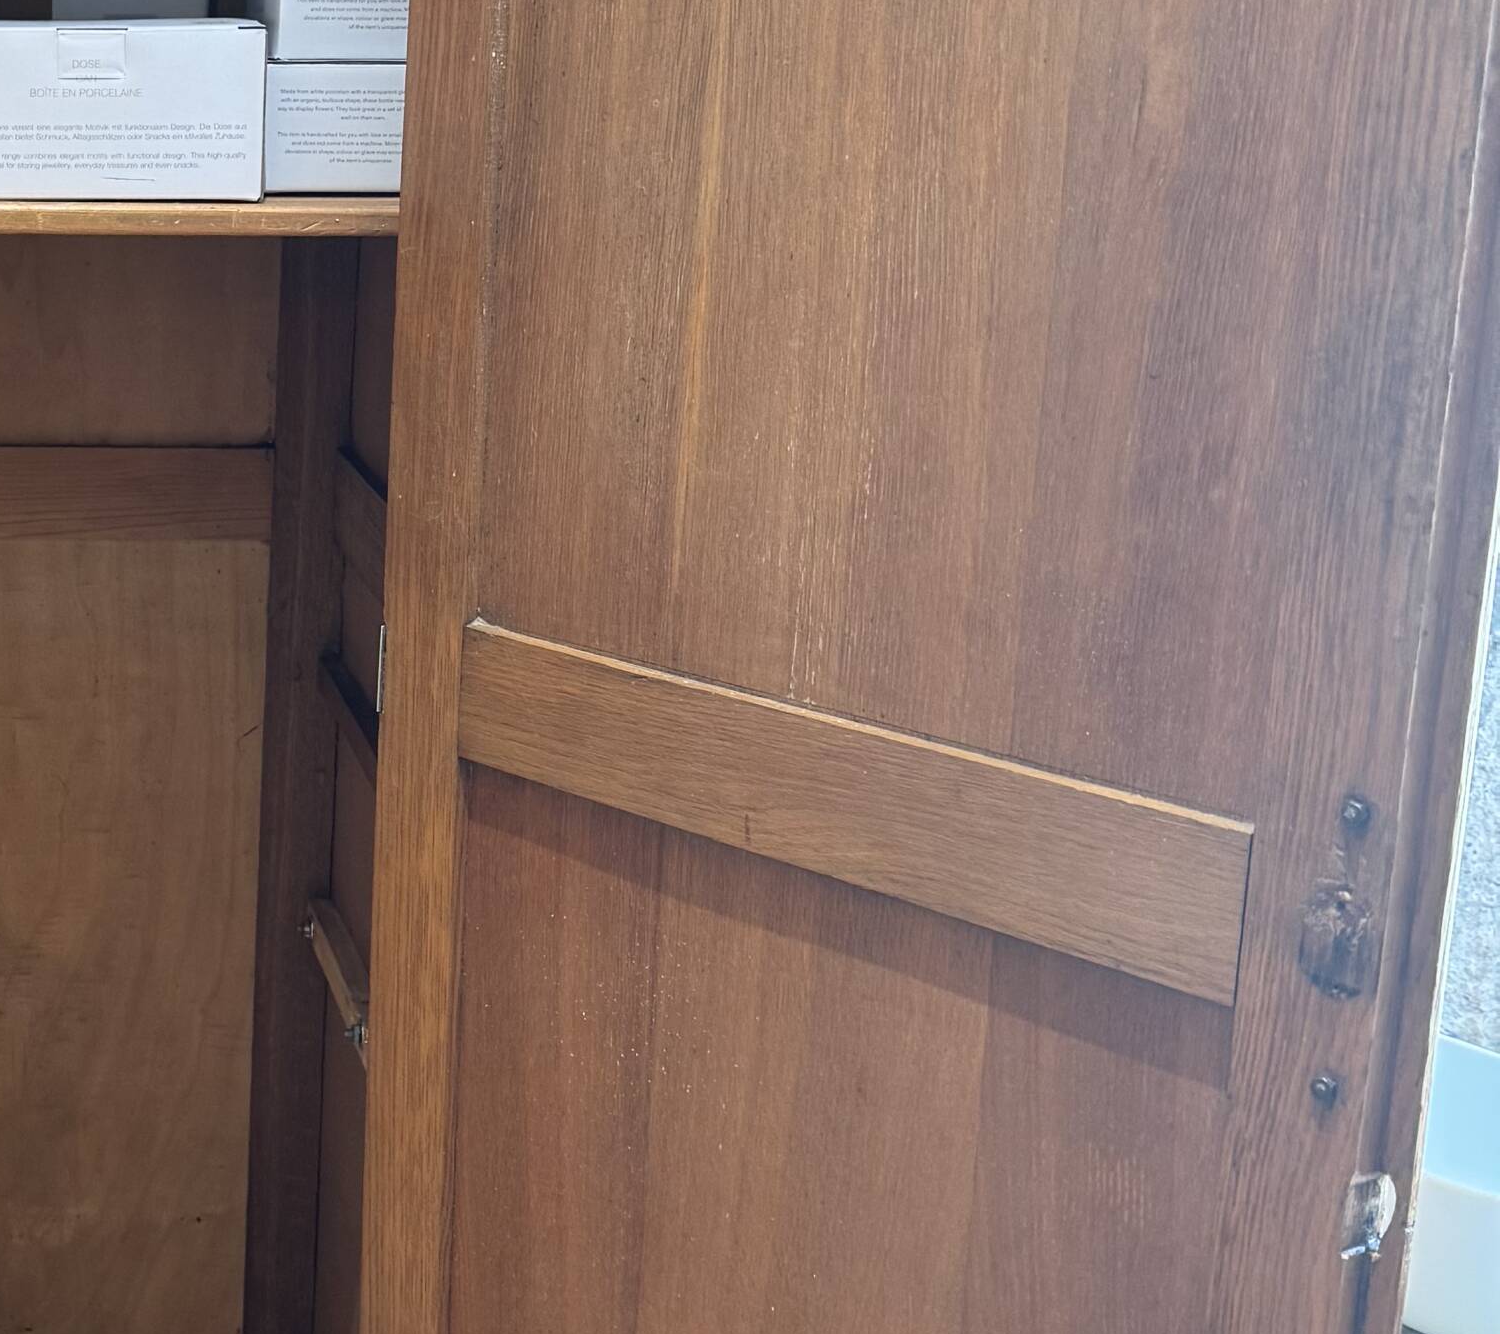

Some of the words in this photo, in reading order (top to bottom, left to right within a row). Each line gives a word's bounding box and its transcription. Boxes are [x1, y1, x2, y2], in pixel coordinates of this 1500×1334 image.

[71, 59, 101, 69] DOSE
[29, 87, 59, 98] BOÎTE
[62, 88, 76, 98] EN
[78, 88, 144, 98] PORCELAINE
